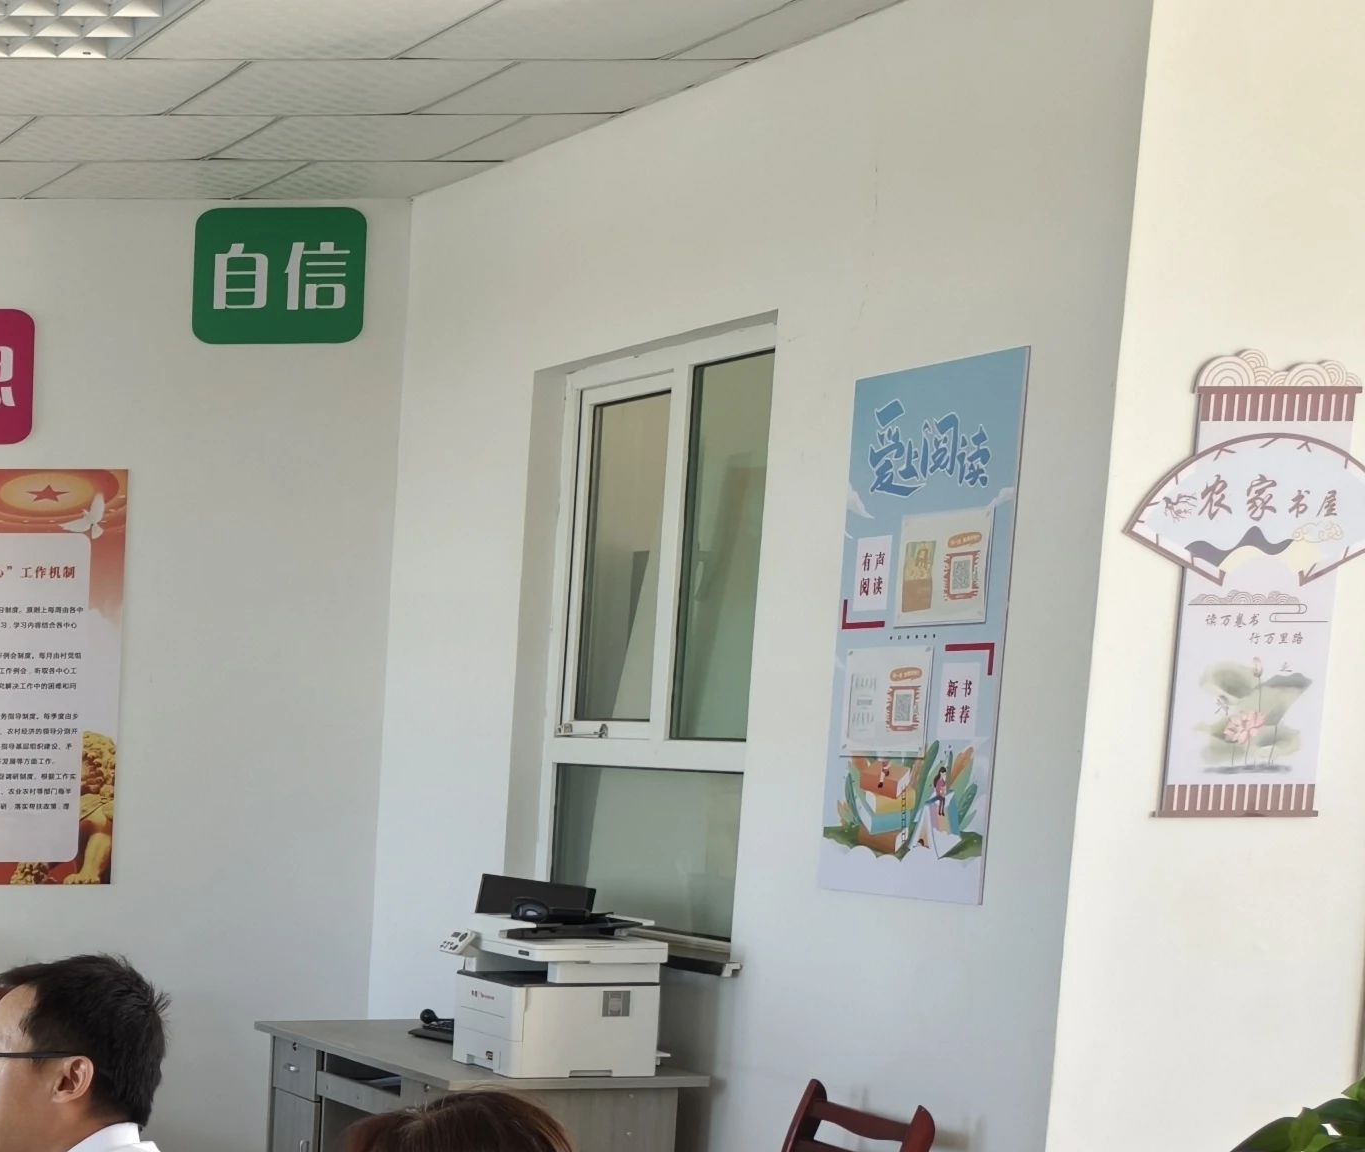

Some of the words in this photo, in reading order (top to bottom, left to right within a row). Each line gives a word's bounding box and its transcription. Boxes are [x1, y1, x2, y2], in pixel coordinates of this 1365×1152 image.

[212, 241, 351, 311] 自信
[869, 398, 990, 498] 爱上阅读
[1198, 473, 1339, 522] 农家书屋
[861, 551, 886, 572] 有声
[859, 576, 883, 596] 阅读
[1205, 612, 1260, 629] 读万卷书
[1248, 631, 1305, 645] 行万里路
[946, 679, 973, 698] 新书
[944, 705, 971, 725] 推荐
